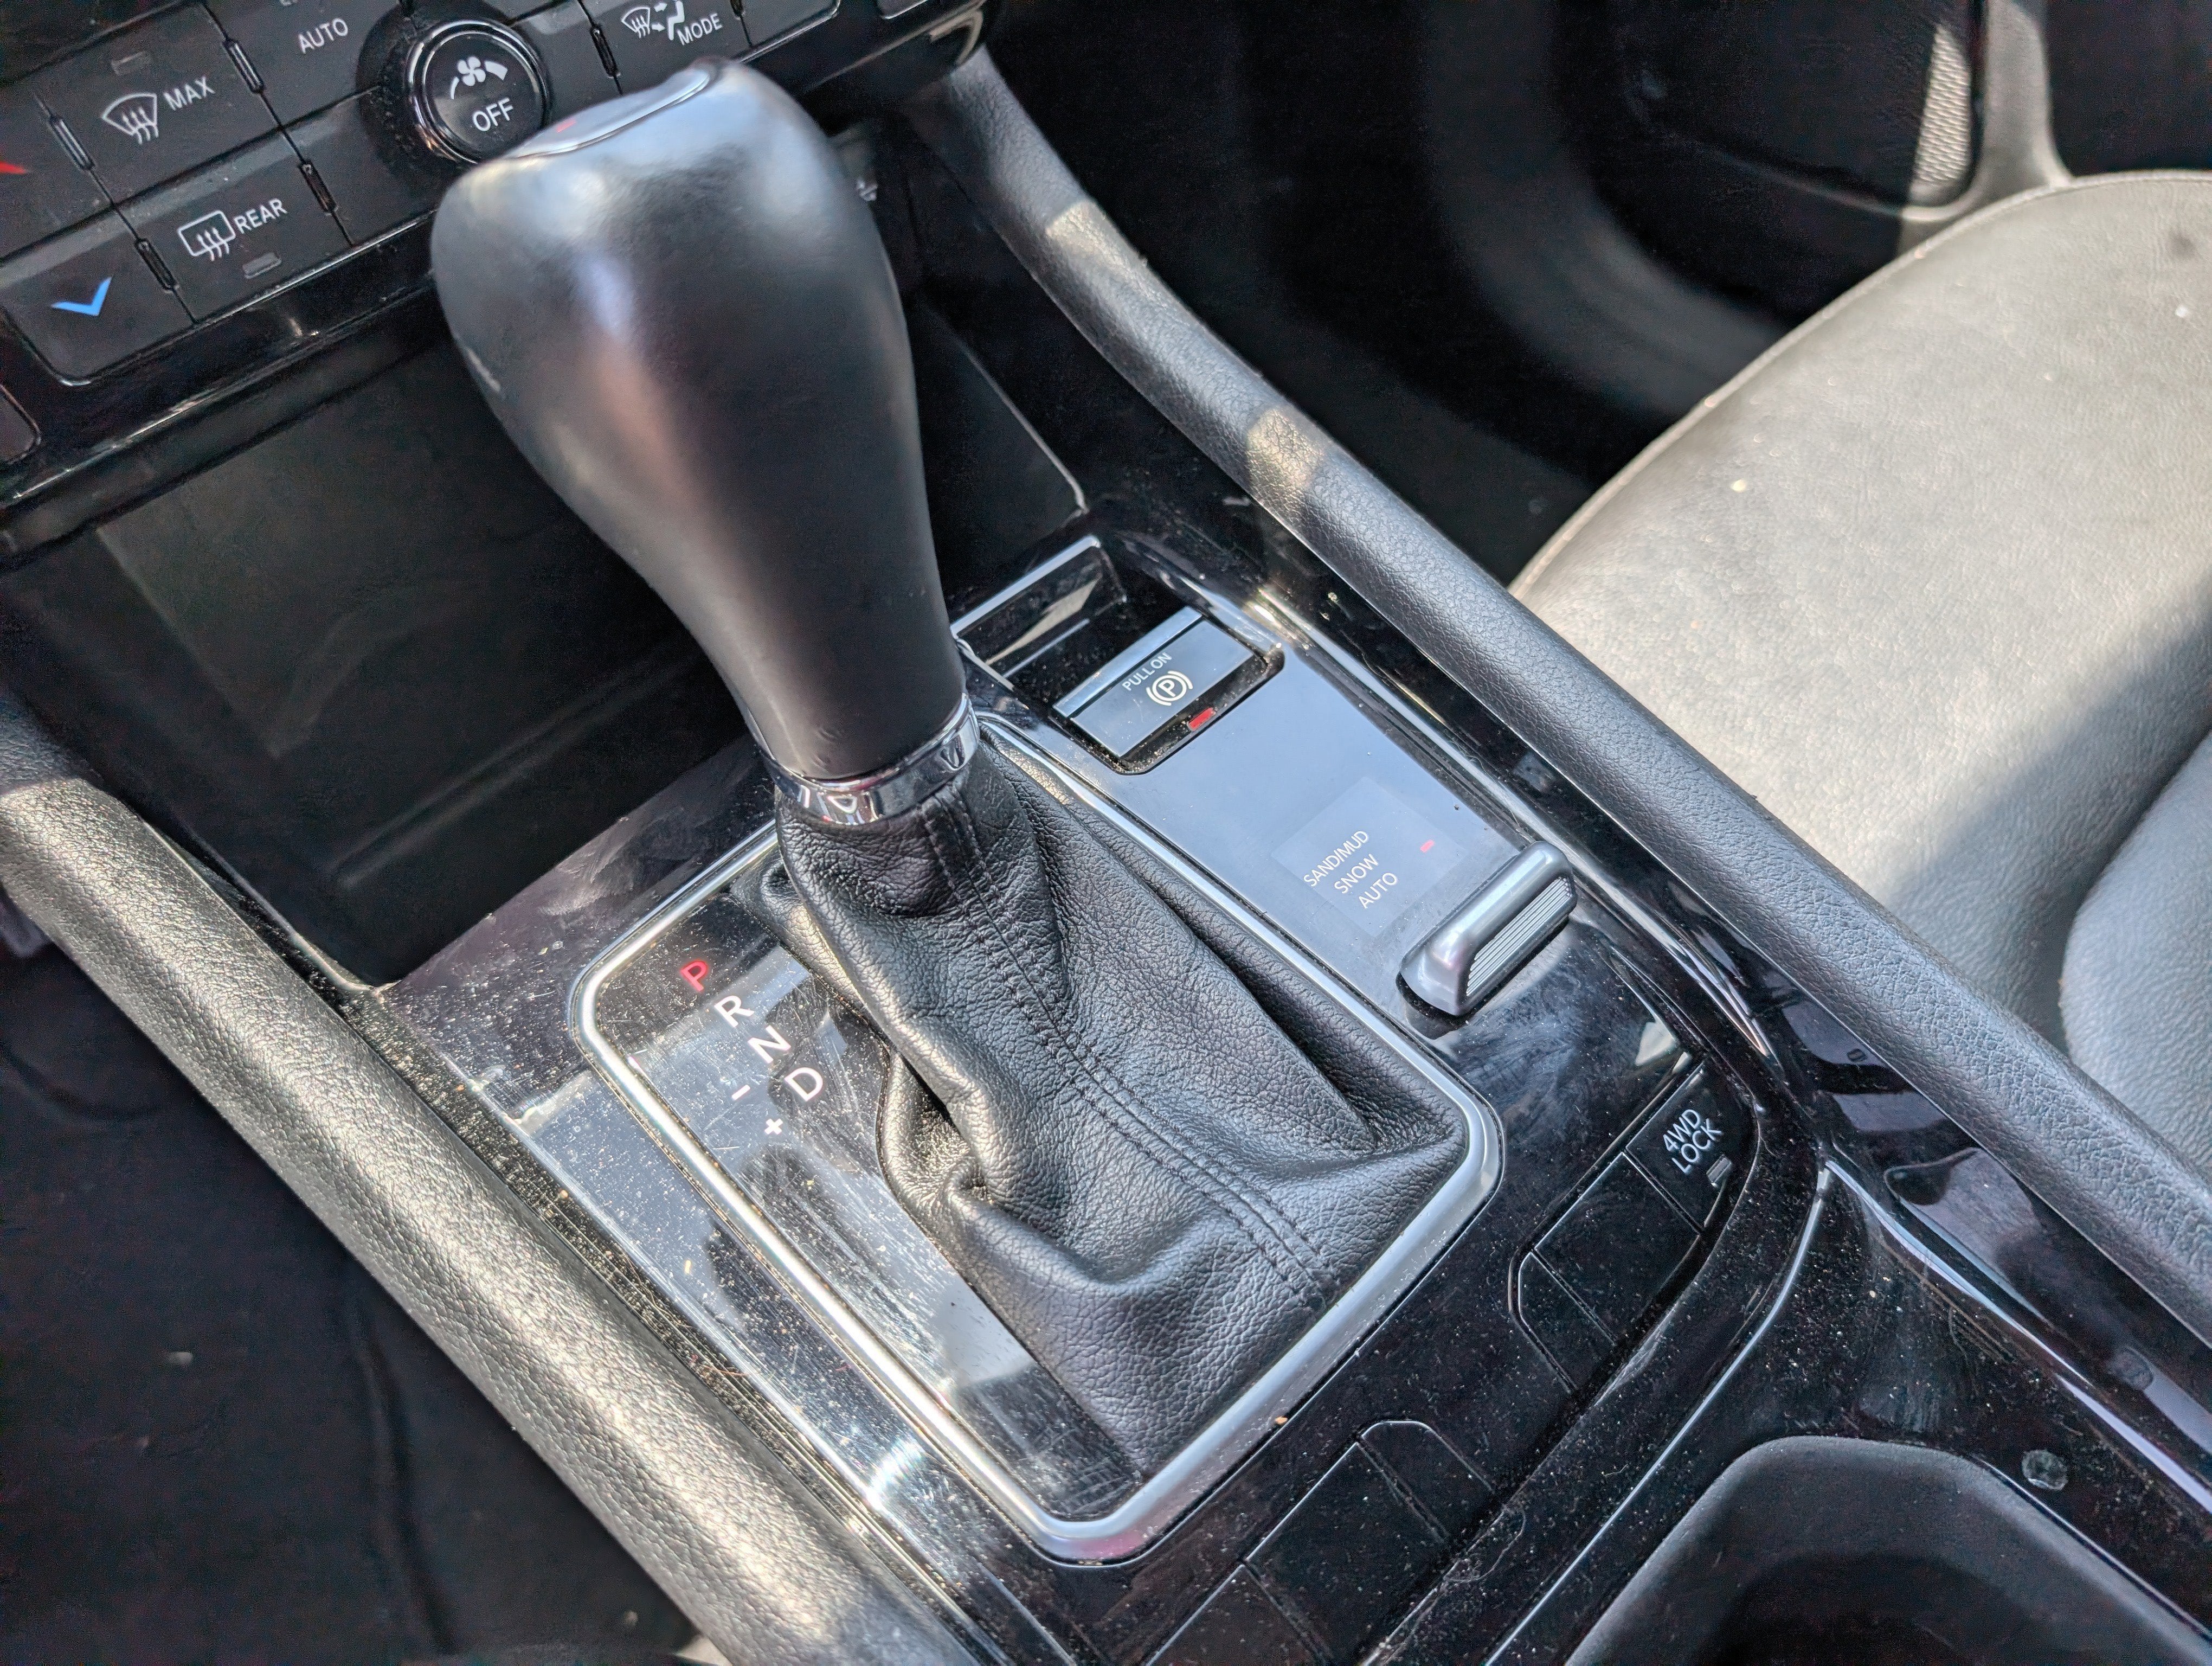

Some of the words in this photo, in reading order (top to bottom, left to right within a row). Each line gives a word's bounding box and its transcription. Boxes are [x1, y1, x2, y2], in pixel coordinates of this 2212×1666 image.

[298, 17, 349, 54] AUTO
[676, 13, 723, 46] MODE
[163, 75, 216, 111] MAX
[472, 98, 514, 132] OFF
[233, 198, 287, 234] REAR
[1122, 667, 1155, 691] PULL
[1150, 652, 1172, 669] ON
[1158, 679, 1176, 697] P
[1303, 830, 1369, 887] SAND/MUD
[1334, 853, 1379, 894] SNOW
[1358, 872, 1398, 909] AUTO
[680, 960, 709, 991] P
[714, 995, 754, 1028] R
[747, 1025, 792, 1064] N
[784, 1067, 824, 1102] D
[1663, 1109, 1701, 1152] 4WD
[1671, 1118, 1723, 1174] LOCK
